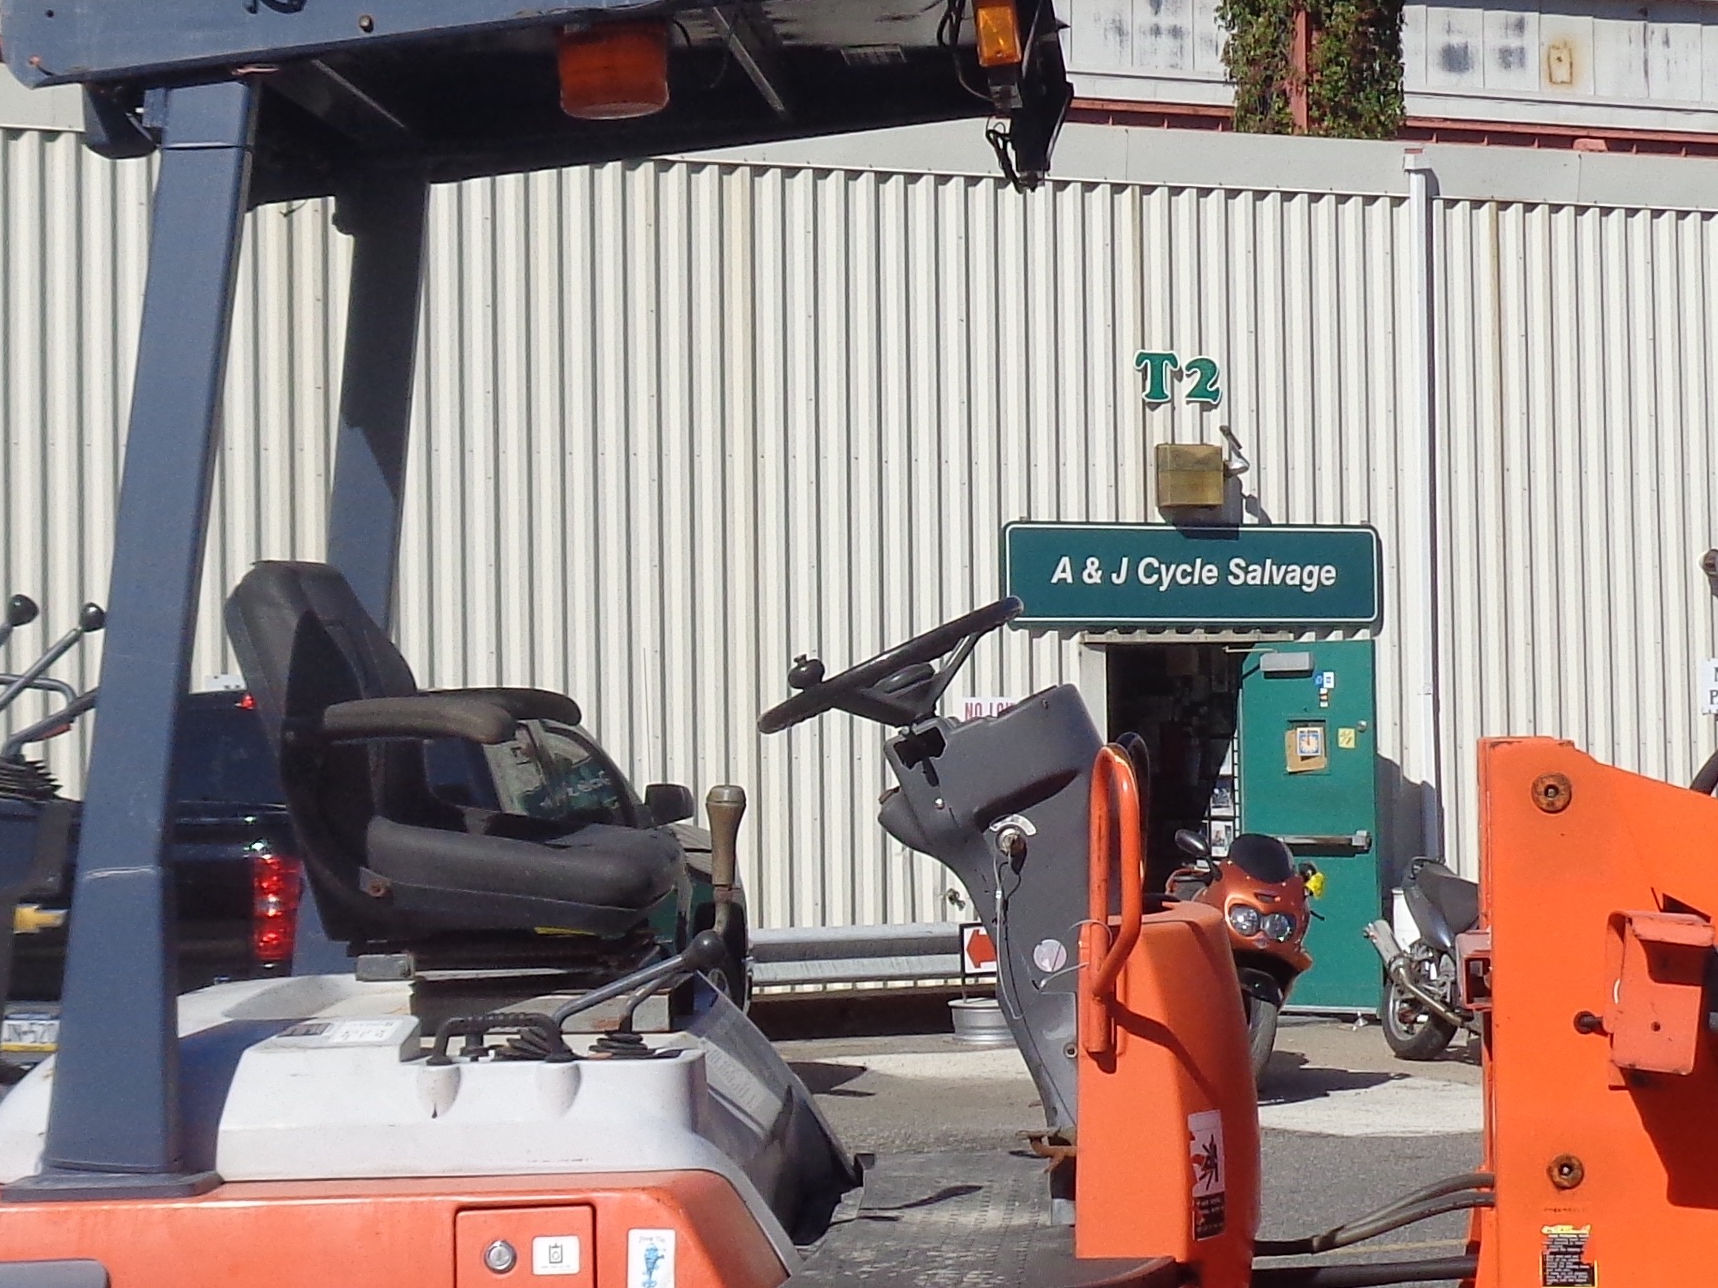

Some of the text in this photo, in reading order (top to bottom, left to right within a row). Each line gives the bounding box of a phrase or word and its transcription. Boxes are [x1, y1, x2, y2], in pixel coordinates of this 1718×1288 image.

[1134, 350, 1222, 404] T2
[1051, 557, 1336, 592] A & J Cycle Salvage
